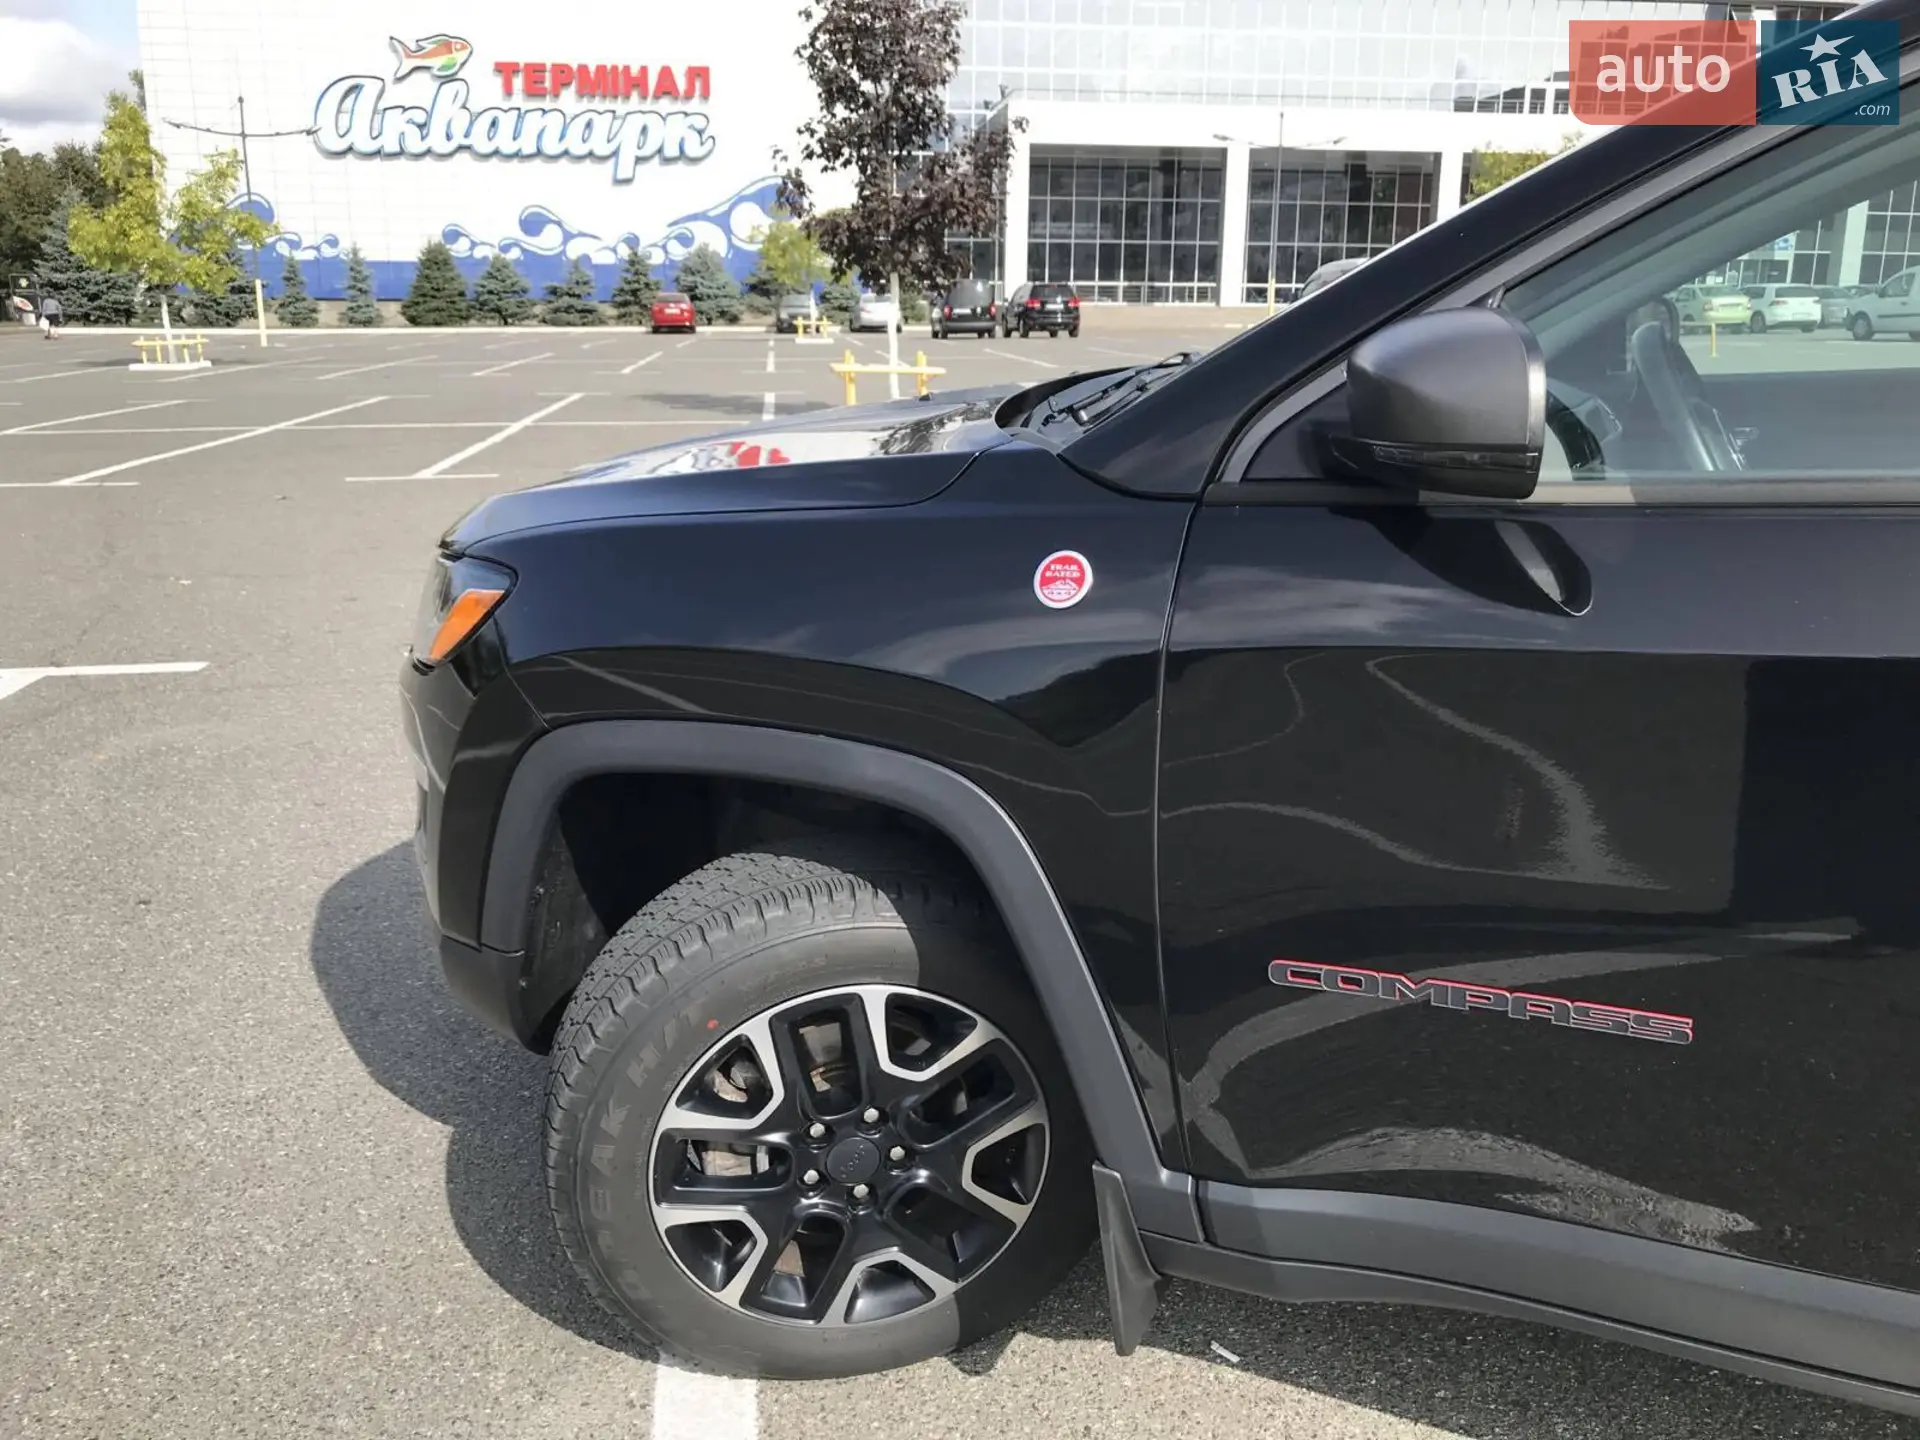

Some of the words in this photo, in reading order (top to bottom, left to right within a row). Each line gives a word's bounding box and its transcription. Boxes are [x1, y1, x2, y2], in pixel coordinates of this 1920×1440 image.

[494, 61, 711, 98] ТЕРМІНАЛ
[313, 75, 716, 184] Аквапарк
[1267, 959, 1694, 1045] COMPASS
